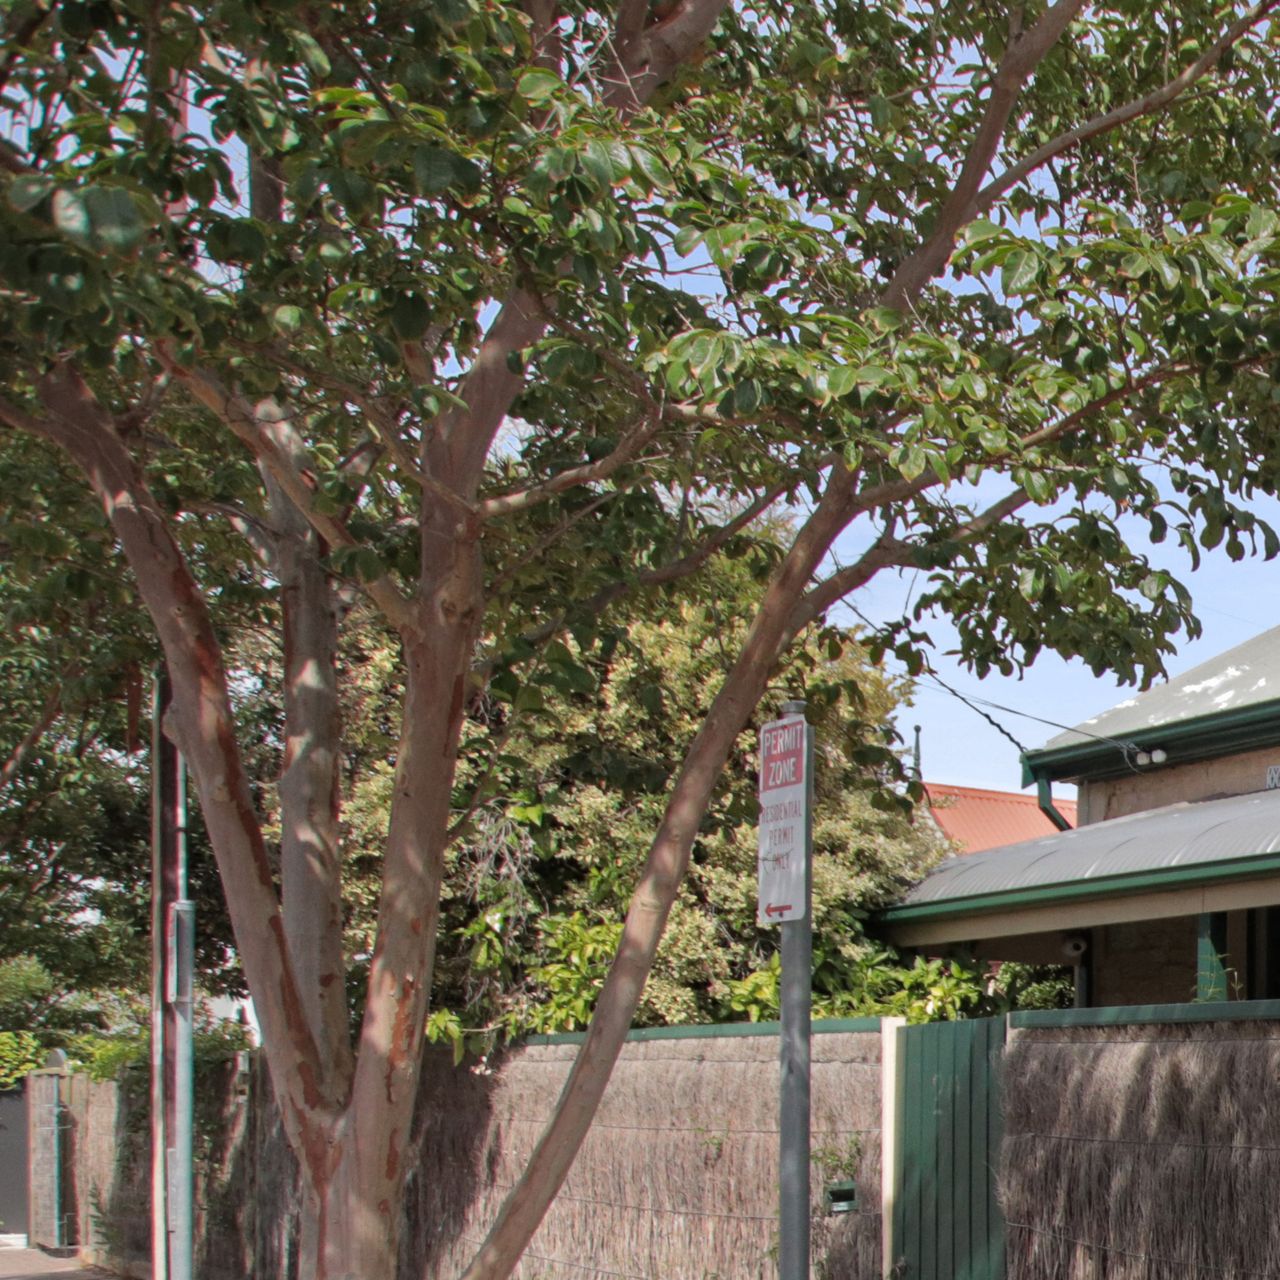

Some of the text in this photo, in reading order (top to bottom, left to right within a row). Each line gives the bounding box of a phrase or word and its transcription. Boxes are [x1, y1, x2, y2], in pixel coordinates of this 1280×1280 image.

[764, 724, 802, 756] PERMIT
[768, 757, 797, 787] ZONE
[761, 799, 802, 824] RESIDENTIAL
[769, 825, 794, 848] PERMIT
